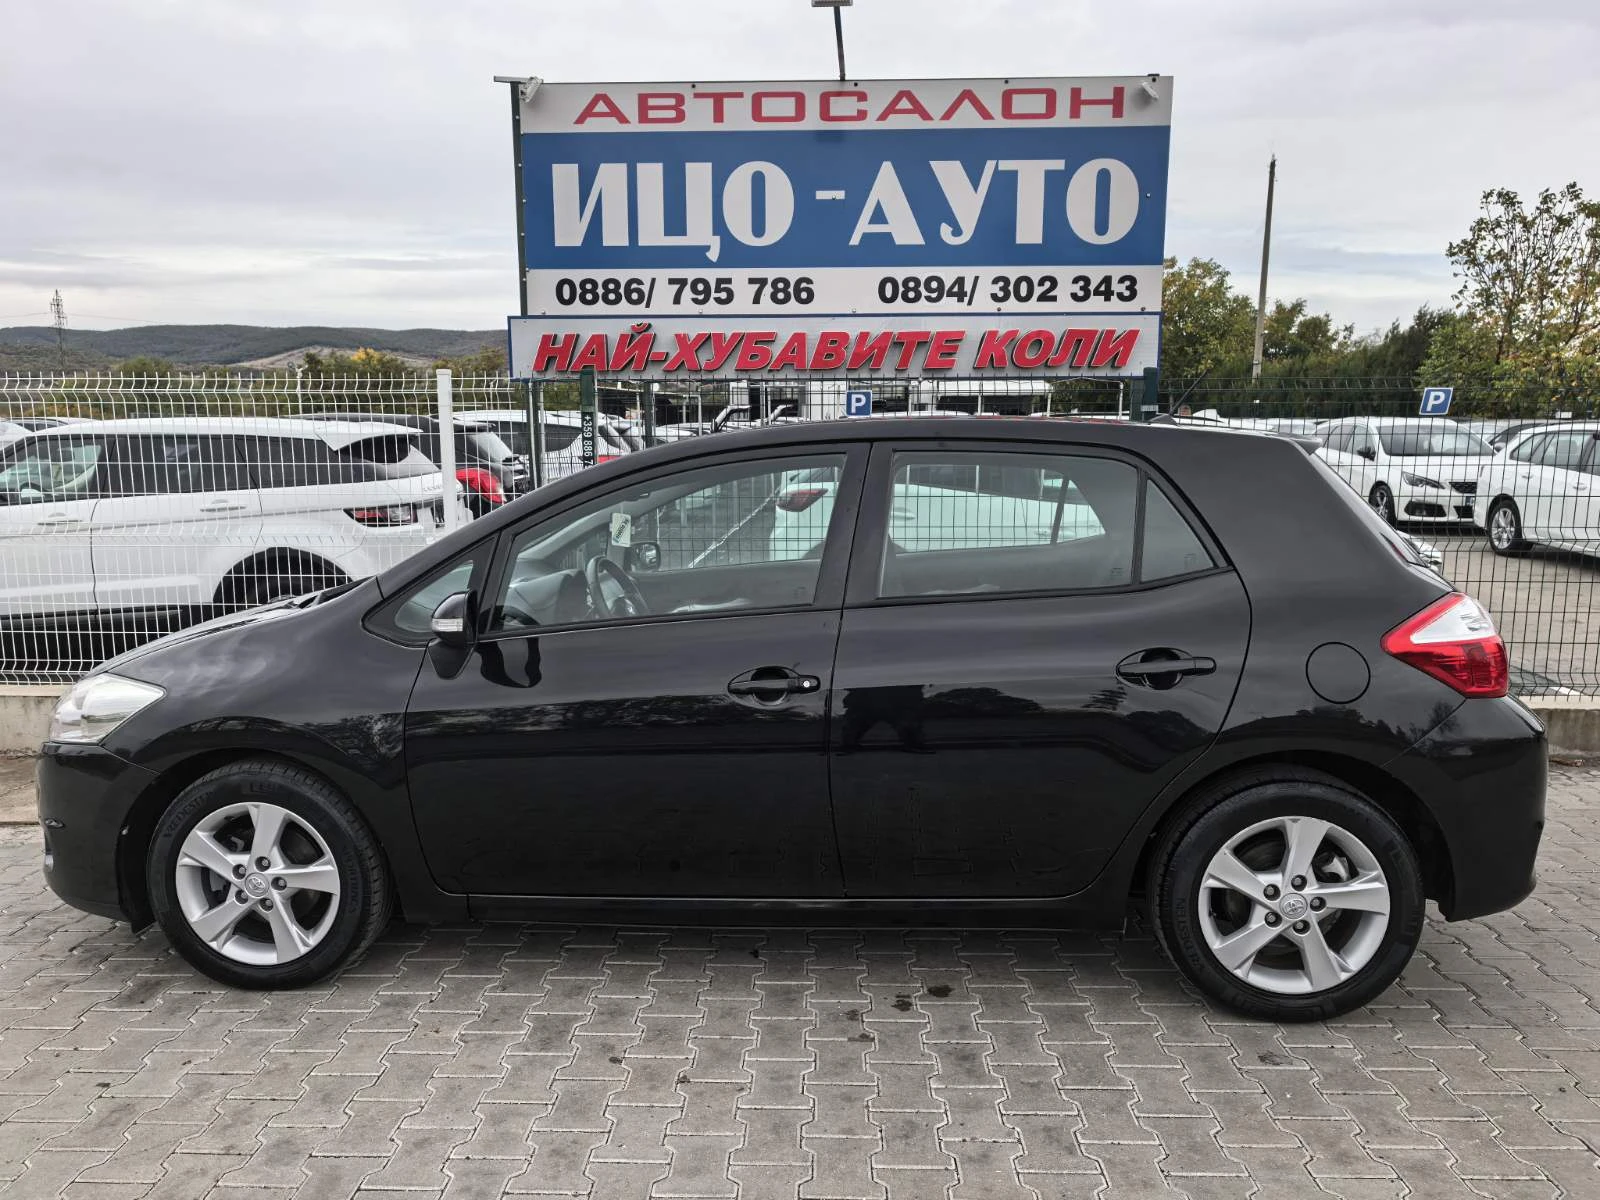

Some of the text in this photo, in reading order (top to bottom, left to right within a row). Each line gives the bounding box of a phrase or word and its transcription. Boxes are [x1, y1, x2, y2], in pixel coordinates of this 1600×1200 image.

[573, 86, 1125, 125] АВТОСАЛОН
[555, 277, 815, 308] 0886/ 795 786
[877, 274, 1139, 307] 0894/ 302 343
[531, 321, 1143, 373] НАЙ-ХУБАВИТЕ КОЛИ
[851, 394, 866, 414] P
[1426, 391, 1446, 412] P
[583, 415, 593, 438] +359
[583, 440, 593, 457] 886
